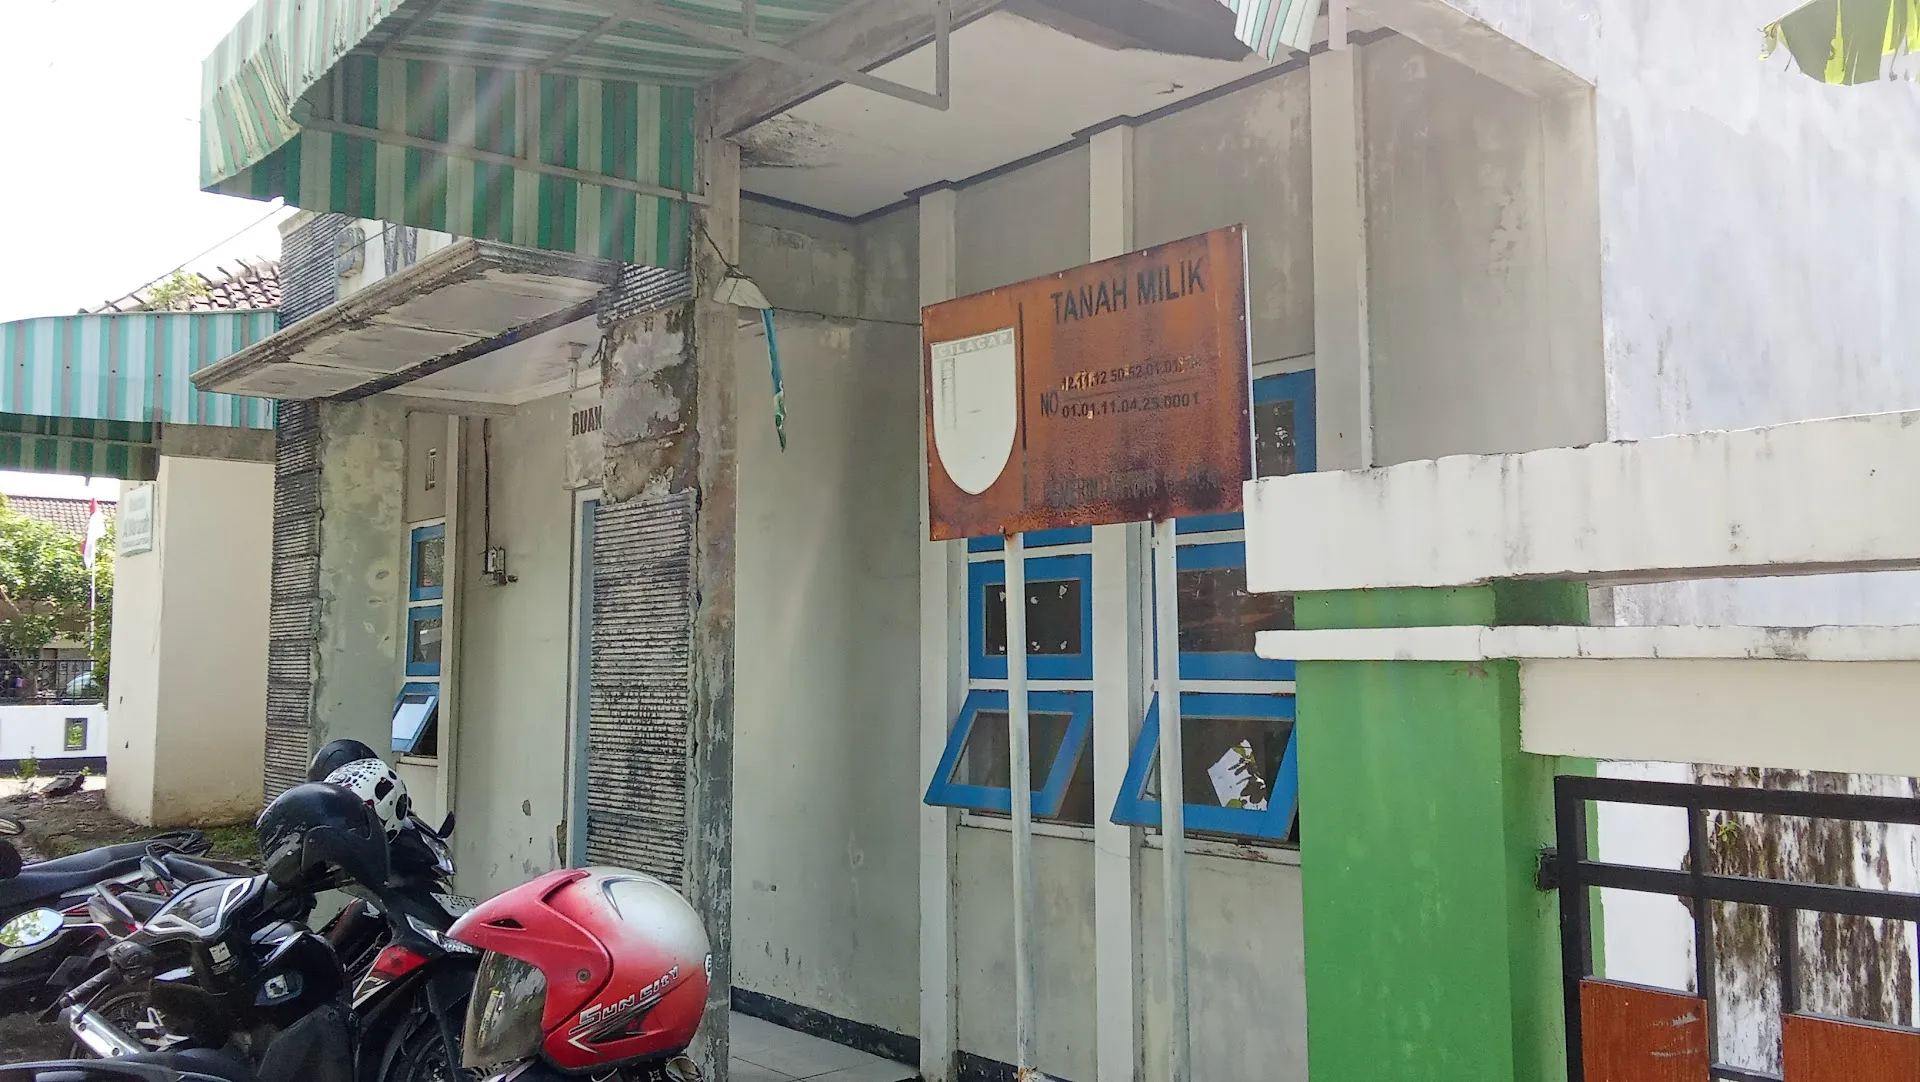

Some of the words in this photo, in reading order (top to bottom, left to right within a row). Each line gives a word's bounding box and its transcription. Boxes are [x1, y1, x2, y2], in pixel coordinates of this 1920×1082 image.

[1050, 277, 1127, 324] TANAH
[1137, 257, 1205, 306] MILIK
[579, 994, 635, 1025] SUN
